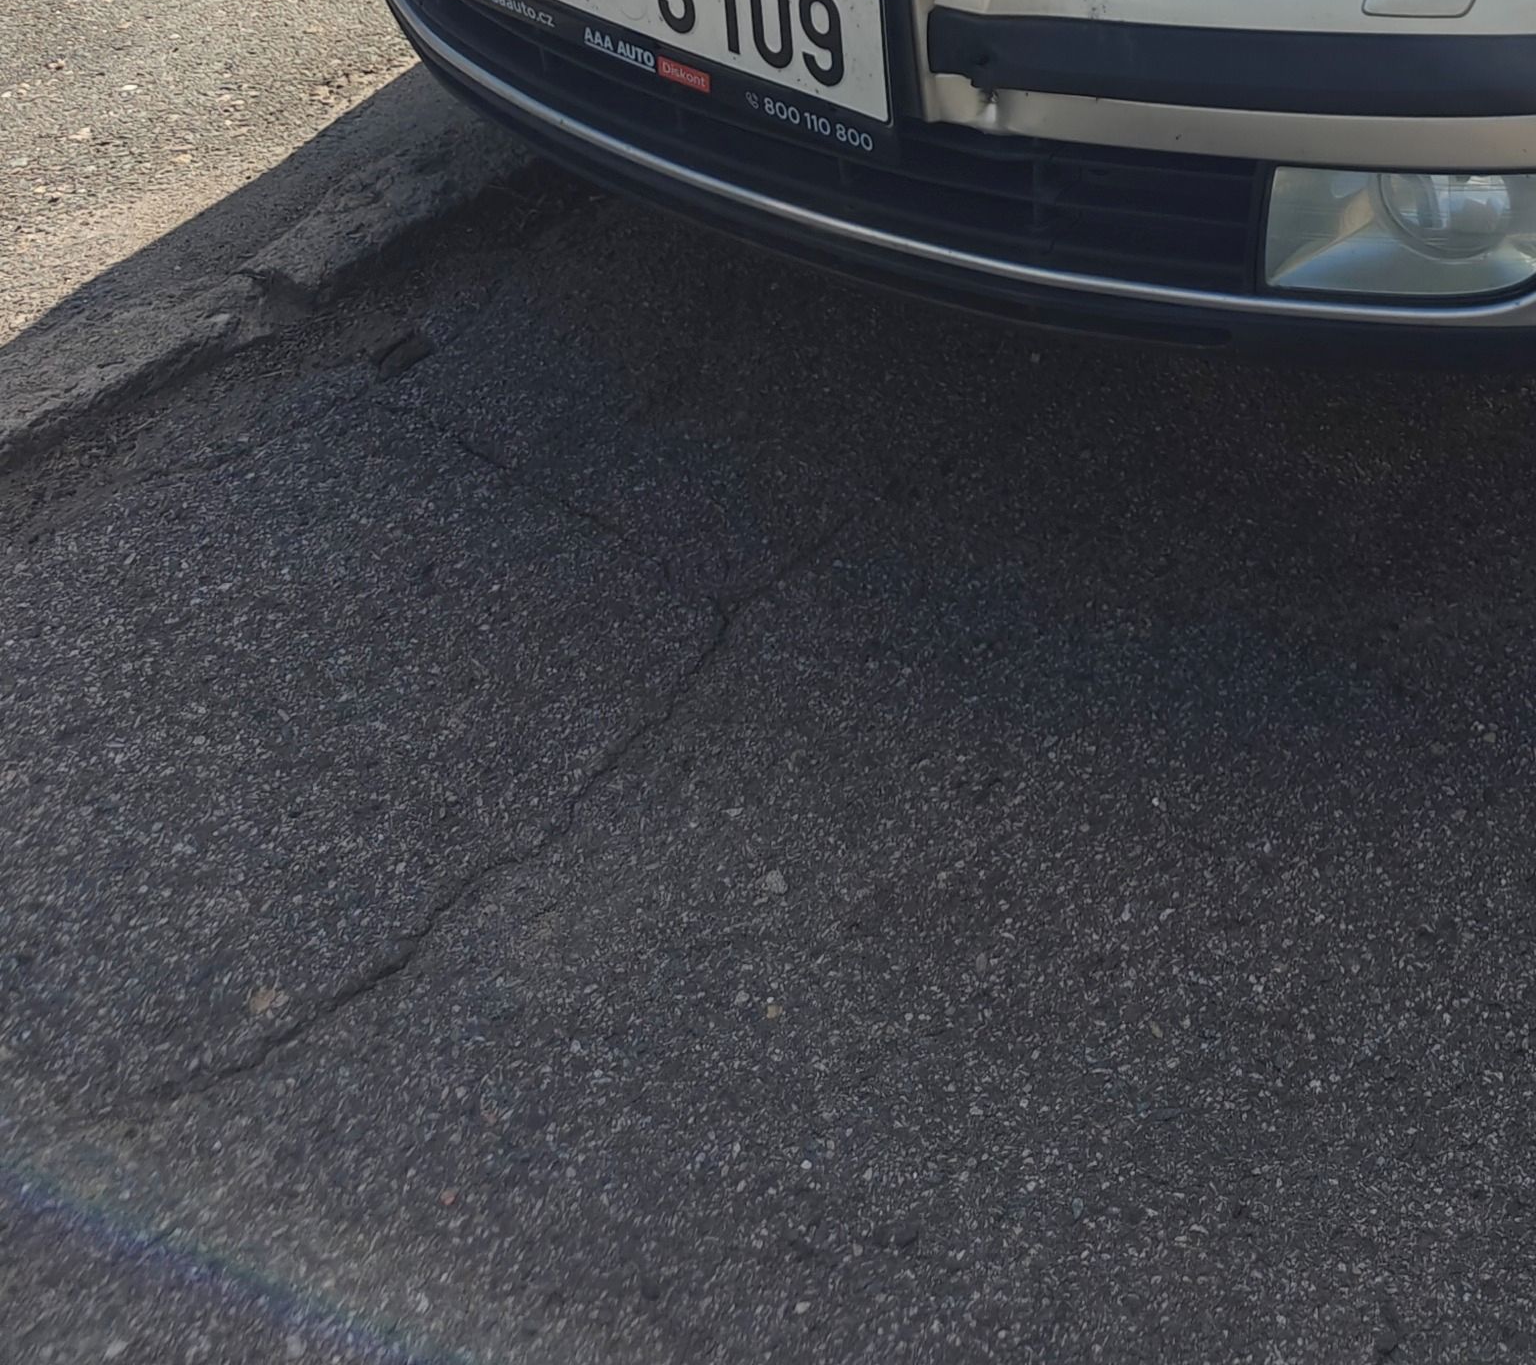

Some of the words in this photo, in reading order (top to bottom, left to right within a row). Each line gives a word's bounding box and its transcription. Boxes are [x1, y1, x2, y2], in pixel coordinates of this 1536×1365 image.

[584, 27, 614, 51] AAA
[617, 40, 656, 68] AUTO
[662, 60, 707, 88] Diskont
[763, 97, 801, 125] 800
[803, 112, 831, 136] 110
[835, 123, 874, 152] 800
